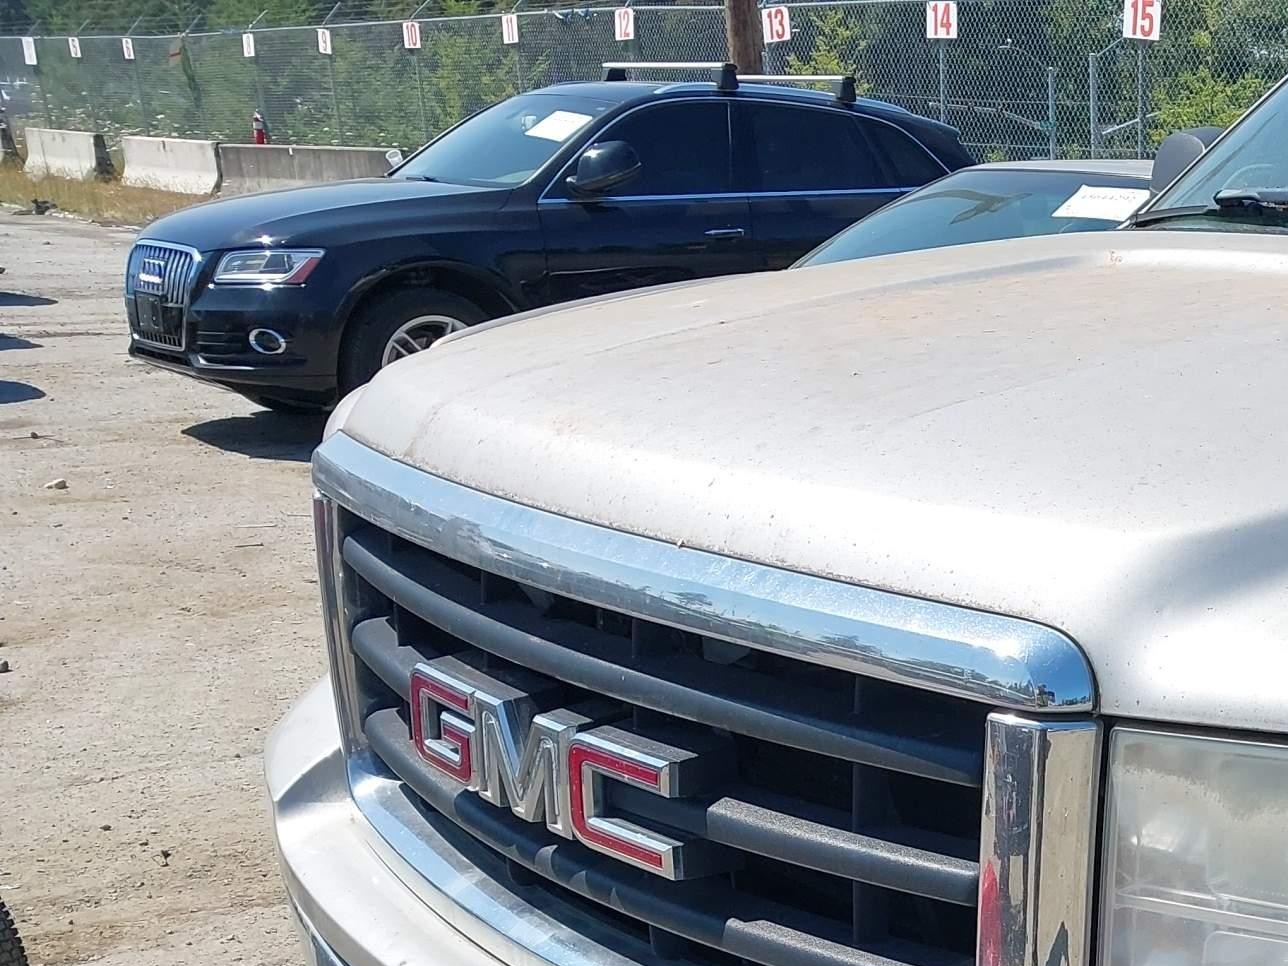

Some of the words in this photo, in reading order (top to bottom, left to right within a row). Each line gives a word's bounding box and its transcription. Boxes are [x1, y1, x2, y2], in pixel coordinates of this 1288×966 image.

[505, 15, 516, 42] 11
[617, 10, 630, 38] 12
[766, 9, 786, 40] 13
[931, 2, 951, 36] 14
[1130, 0, 1154, 37] 15
[320, 31, 328, 51] 9
[404, 23, 417, 47] 10
[410, 660, 690, 881] GMC
